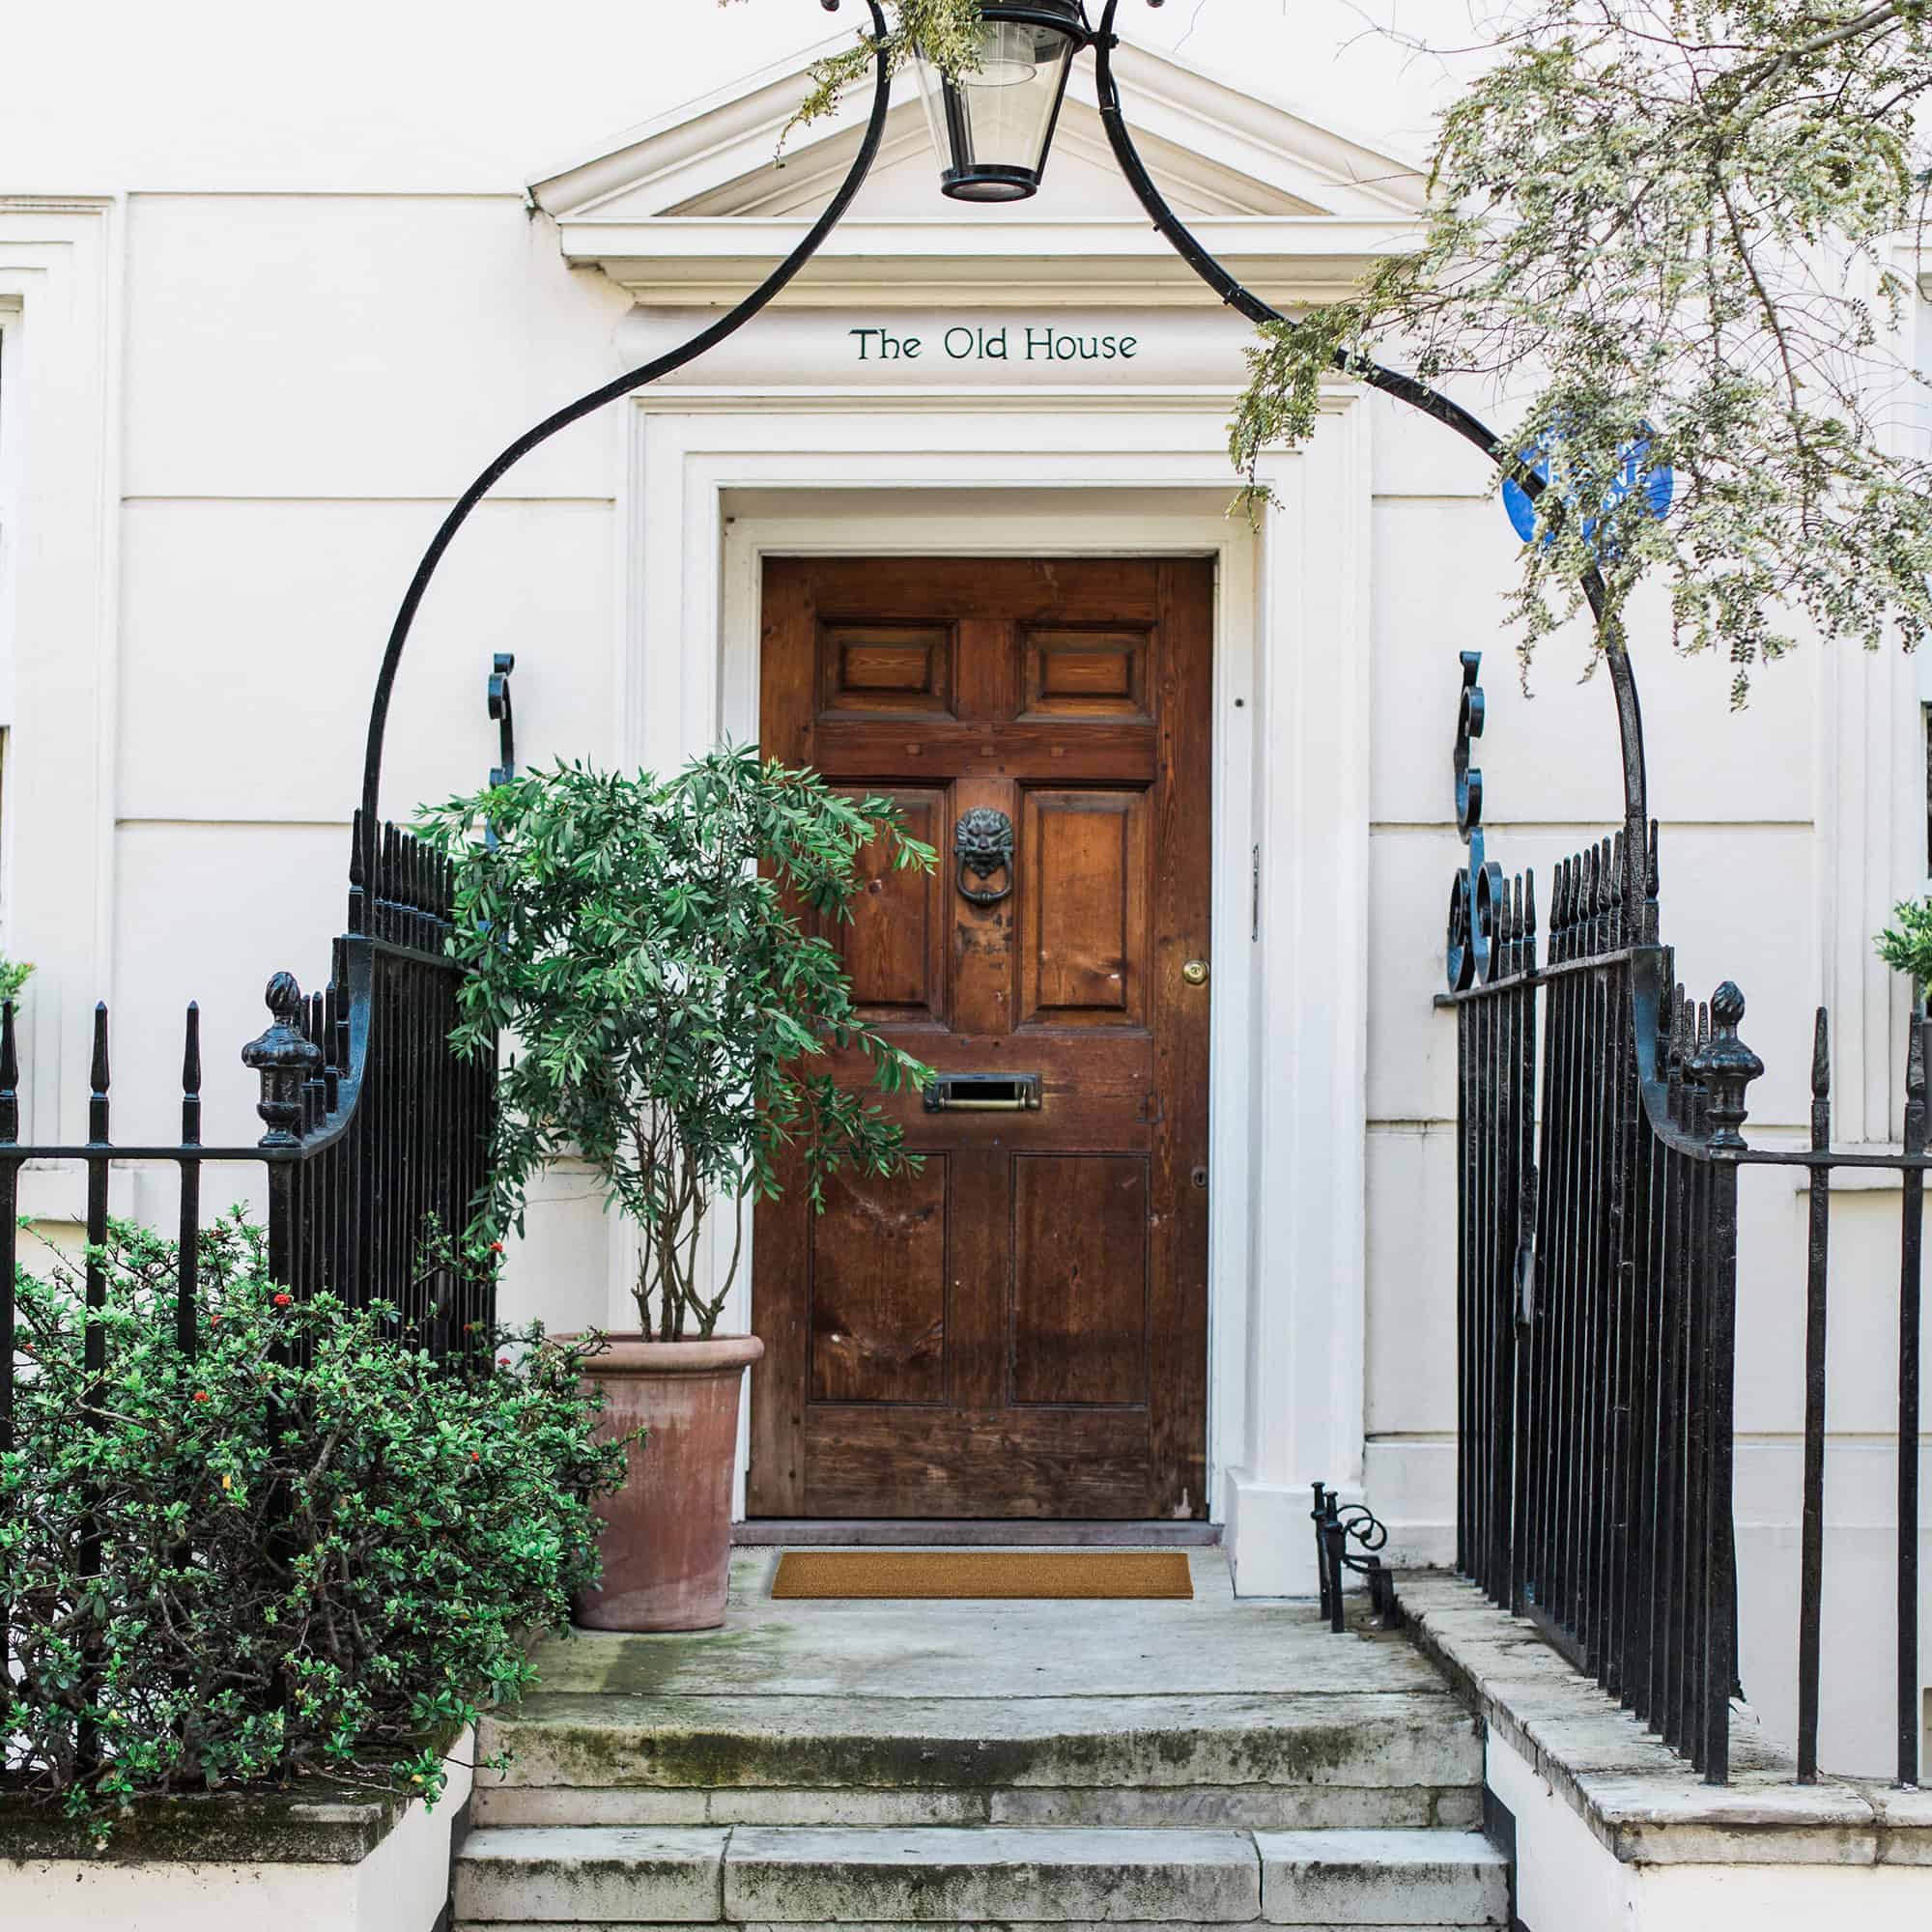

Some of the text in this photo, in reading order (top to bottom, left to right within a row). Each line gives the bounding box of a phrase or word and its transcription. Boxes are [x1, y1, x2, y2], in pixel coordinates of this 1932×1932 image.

[849, 327, 1138, 360] The Old House
